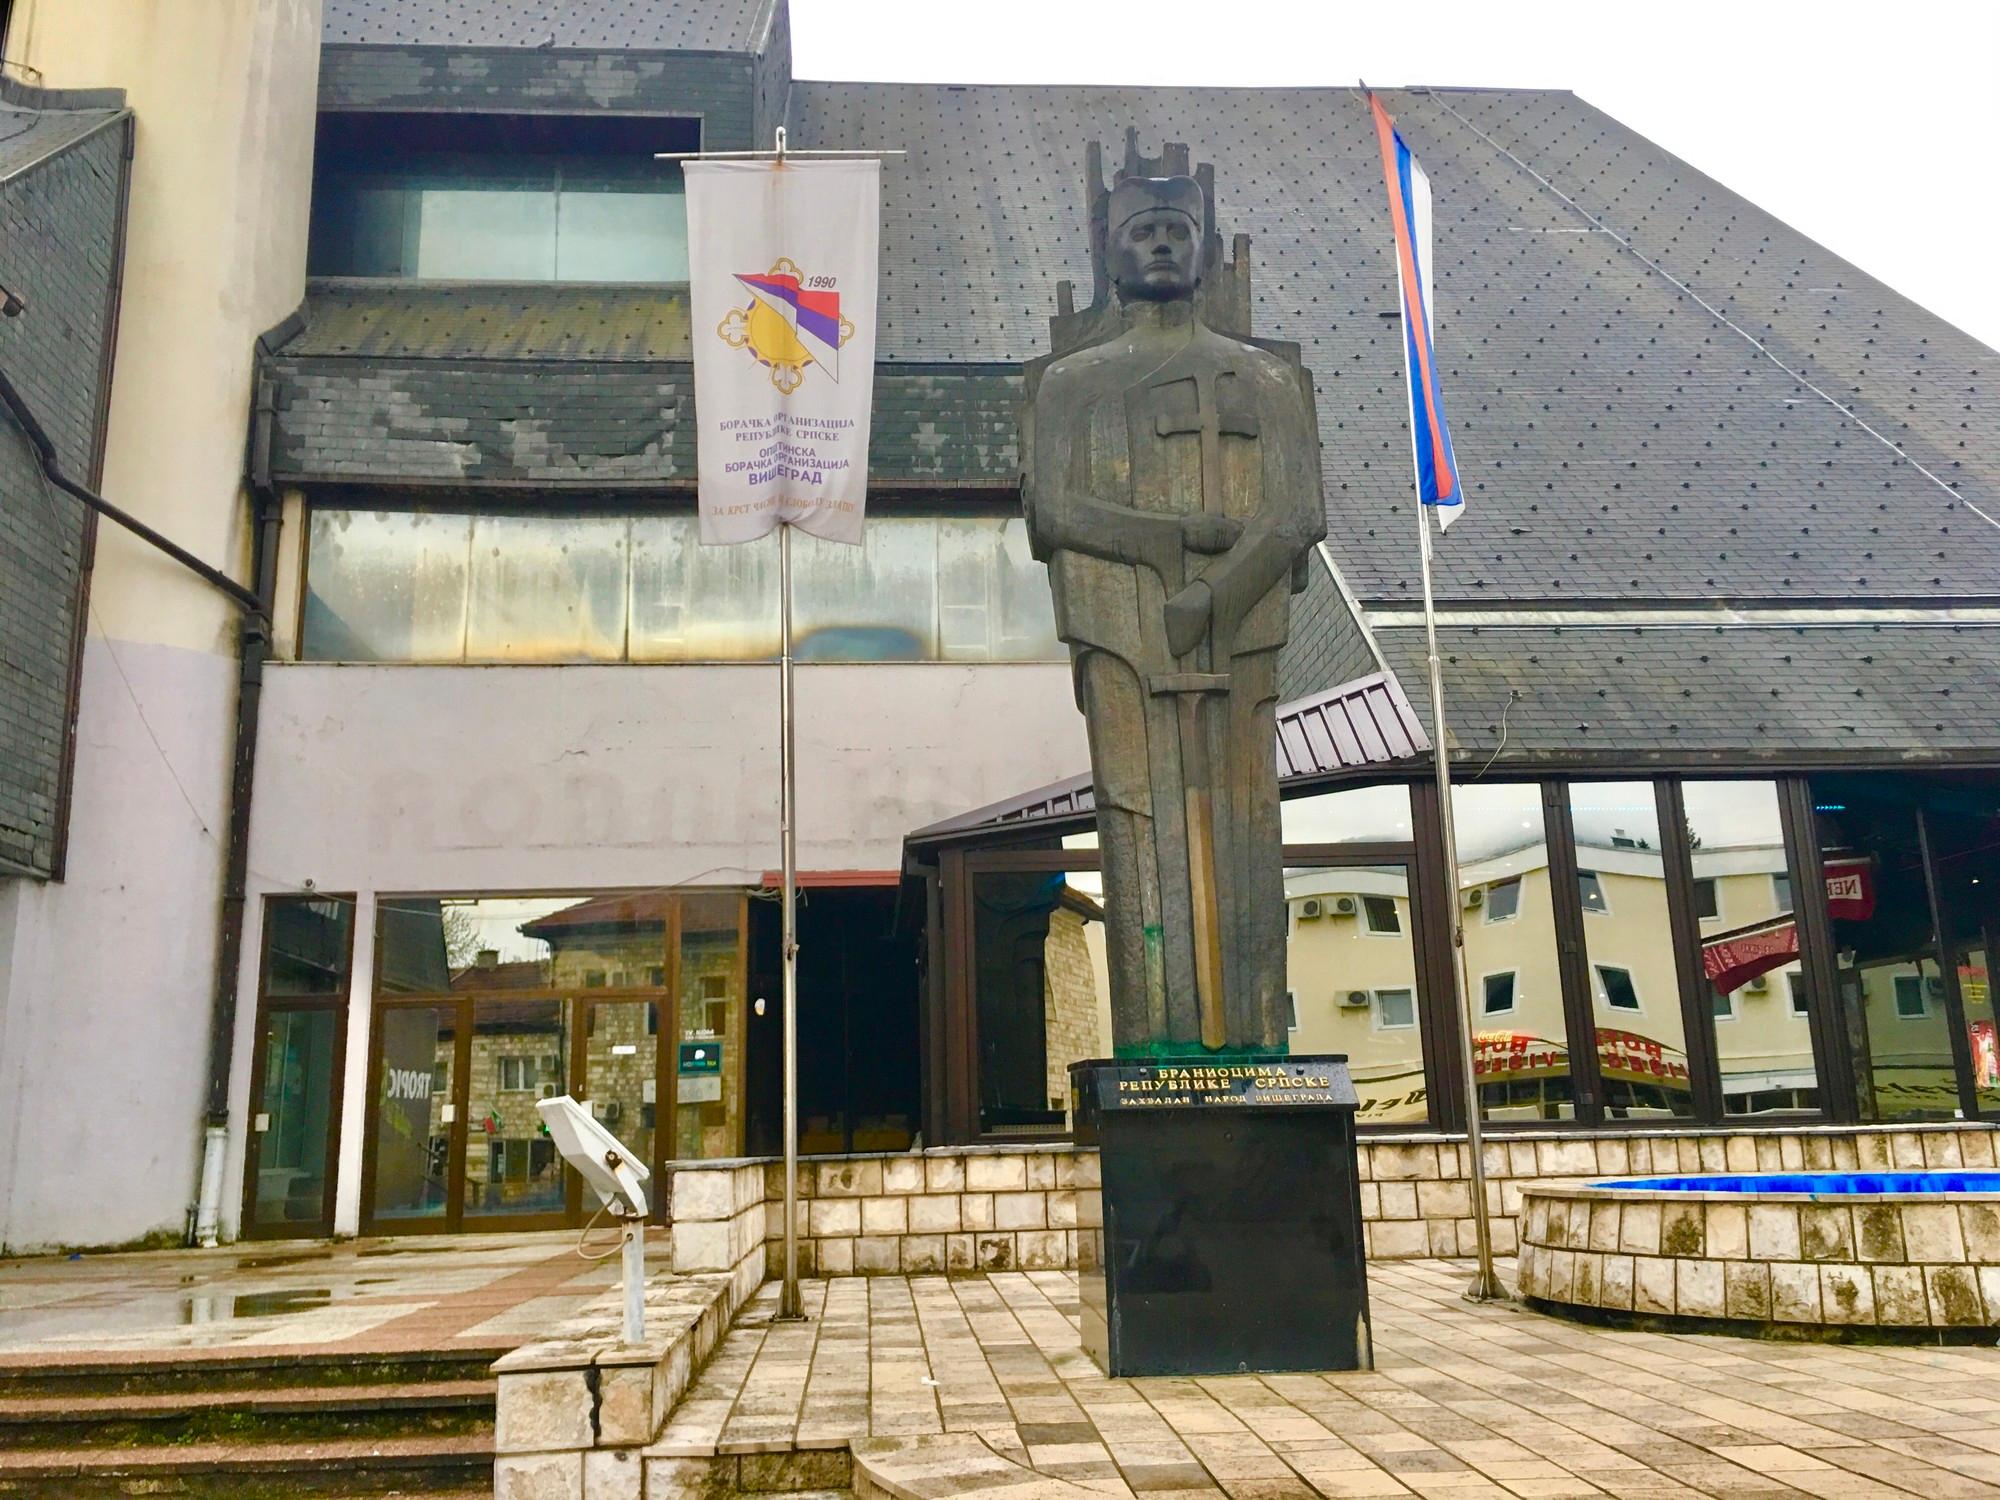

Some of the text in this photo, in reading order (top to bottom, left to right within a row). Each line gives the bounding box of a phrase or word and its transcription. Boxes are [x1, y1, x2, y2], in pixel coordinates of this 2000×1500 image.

[808, 275, 837, 290] 1990
[720, 412, 855, 431] БОРАЧКА ОРГАНИЗАЦИЈА
[735, 424, 840, 442] РЕПУБЛИКЕ СРПСКЕ
[759, 441, 816, 458] ОПШТИНСКА
[725, 452, 849, 473] БОРАЧКА ОРГАНИЗАЦИЈА
[748, 464, 823, 486] ВИШЕГРАД
[1158, 1066, 1287, 1079] БРАНИОЦИМА
[1119, 1076, 1331, 1091] РЕПУБЛИКЕ СРПСКЕ
[1204, 1095, 1247, 1104] НАРОД
[1255, 1093, 1333, 1104] ВИШЕГРАДА
